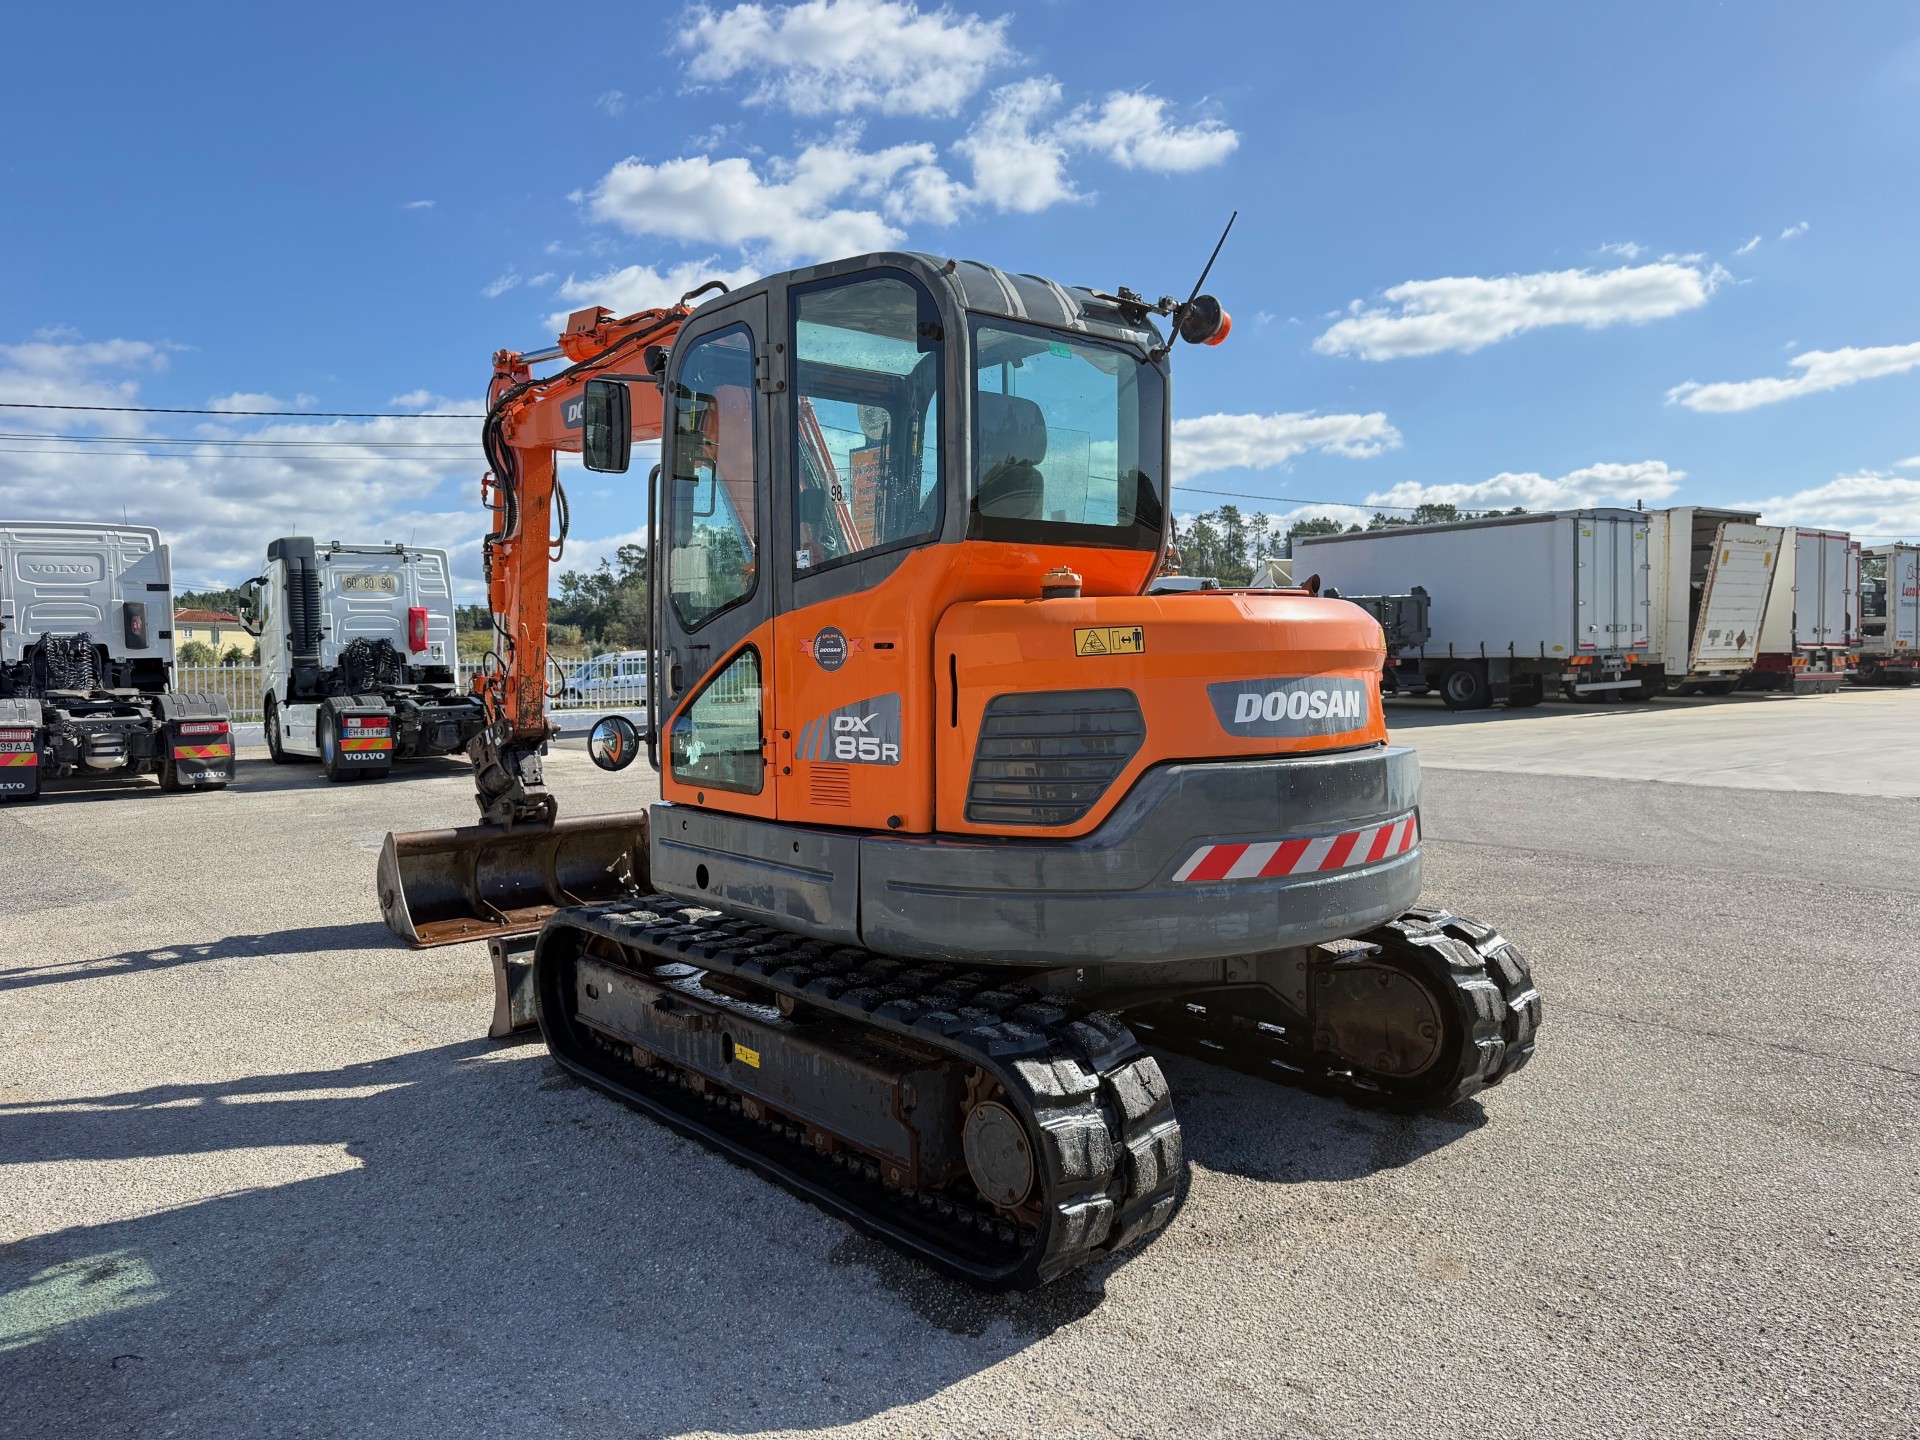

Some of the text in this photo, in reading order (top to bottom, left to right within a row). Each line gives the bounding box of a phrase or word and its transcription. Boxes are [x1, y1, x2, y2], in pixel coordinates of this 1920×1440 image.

[831, 485, 842, 501] 98
[27, 564, 94, 573] VOLVO
[346, 577, 392, 589] 60 80 90
[1234, 690, 1360, 724] DOOSAN
[834, 712, 879, 732] DX
[15, 742, 32, 751] AA
[835, 735, 899, 762] 85R
[344, 752, 386, 761] VOLVO
[187, 771, 227, 779] VOLVO
